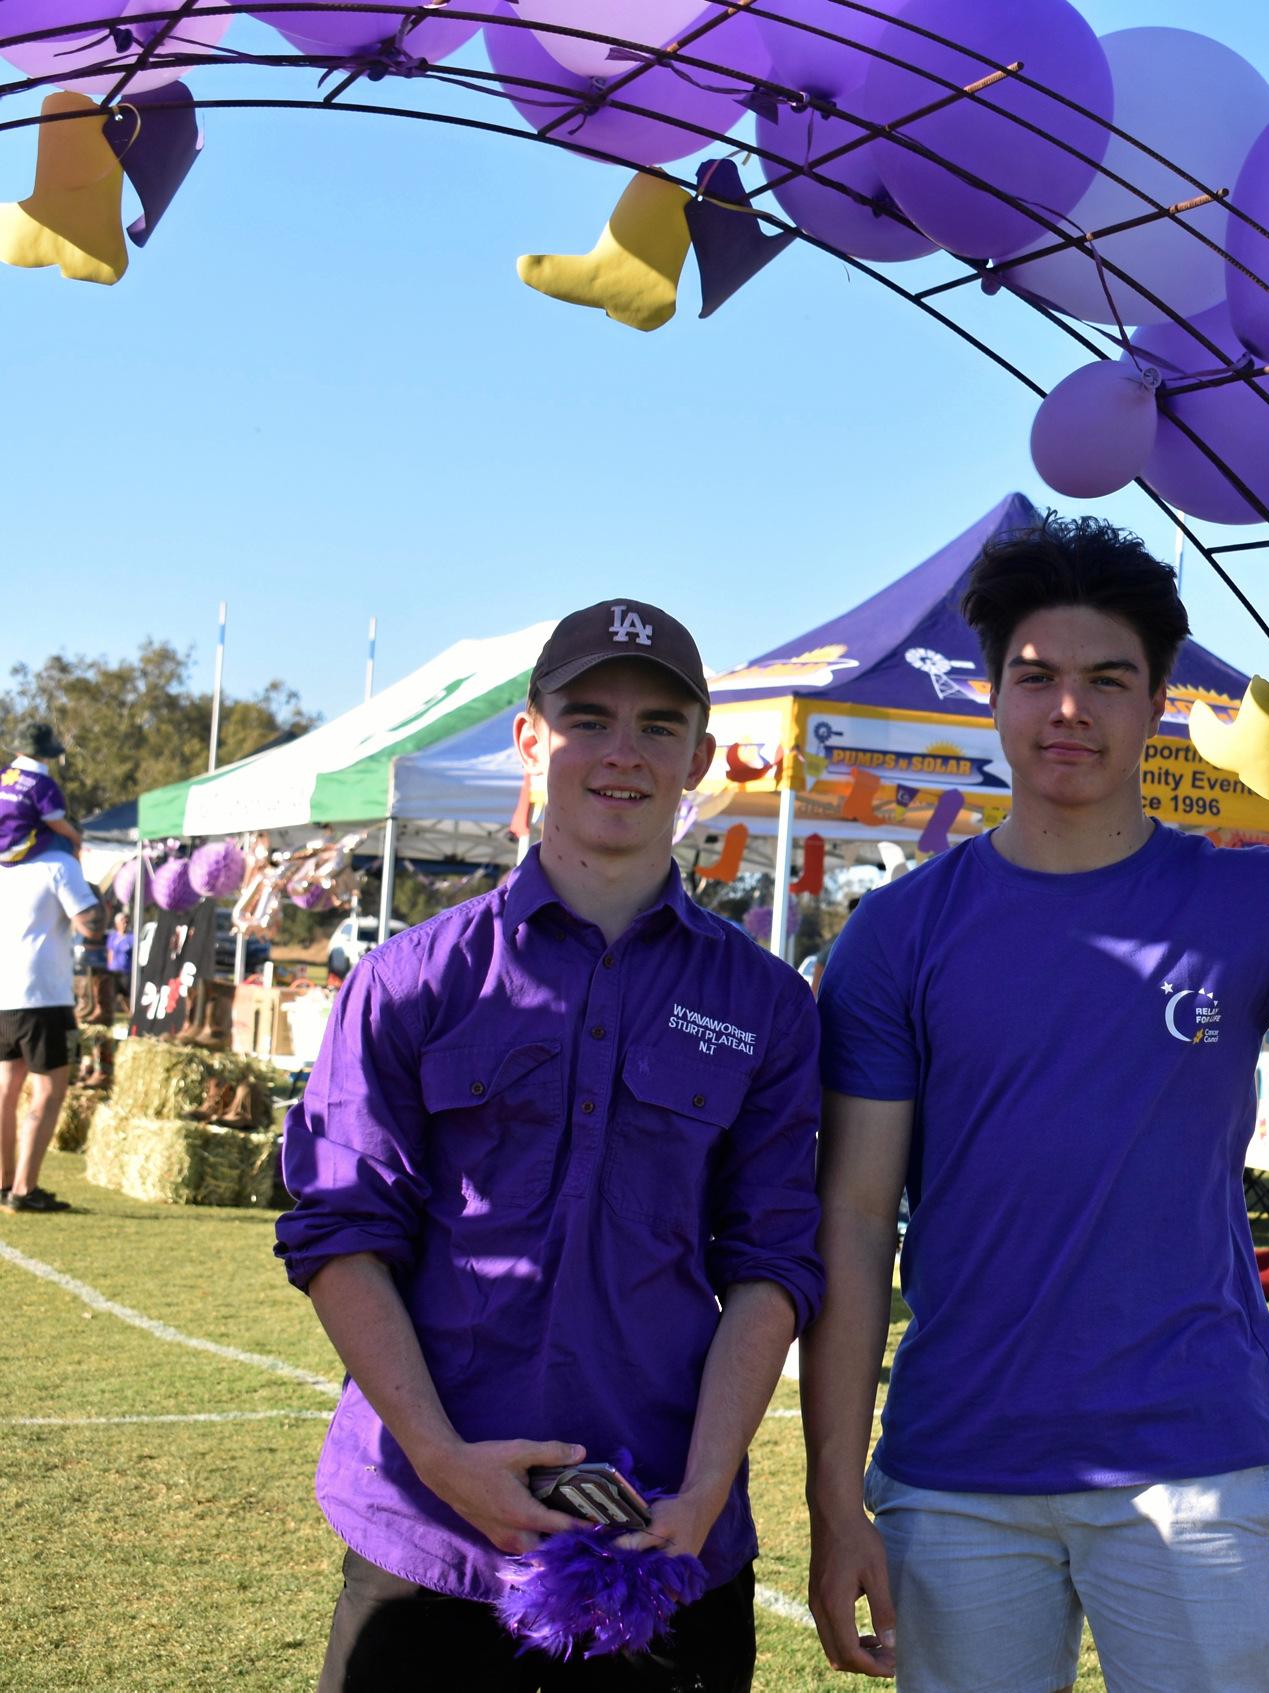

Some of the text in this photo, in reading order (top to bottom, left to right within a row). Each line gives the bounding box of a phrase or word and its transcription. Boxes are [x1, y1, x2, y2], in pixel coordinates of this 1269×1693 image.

[609, 605, 653, 646] LA
[832, 749, 897, 769] PUMPS
[911, 756, 973, 775] SOLAR
[1142, 767, 1254, 796] nity Even
[1170, 795, 1221, 816] 1996
[1196, 1008, 1219, 1016] RELAY
[668, 1016, 754, 1055] STURT PLATEAU
